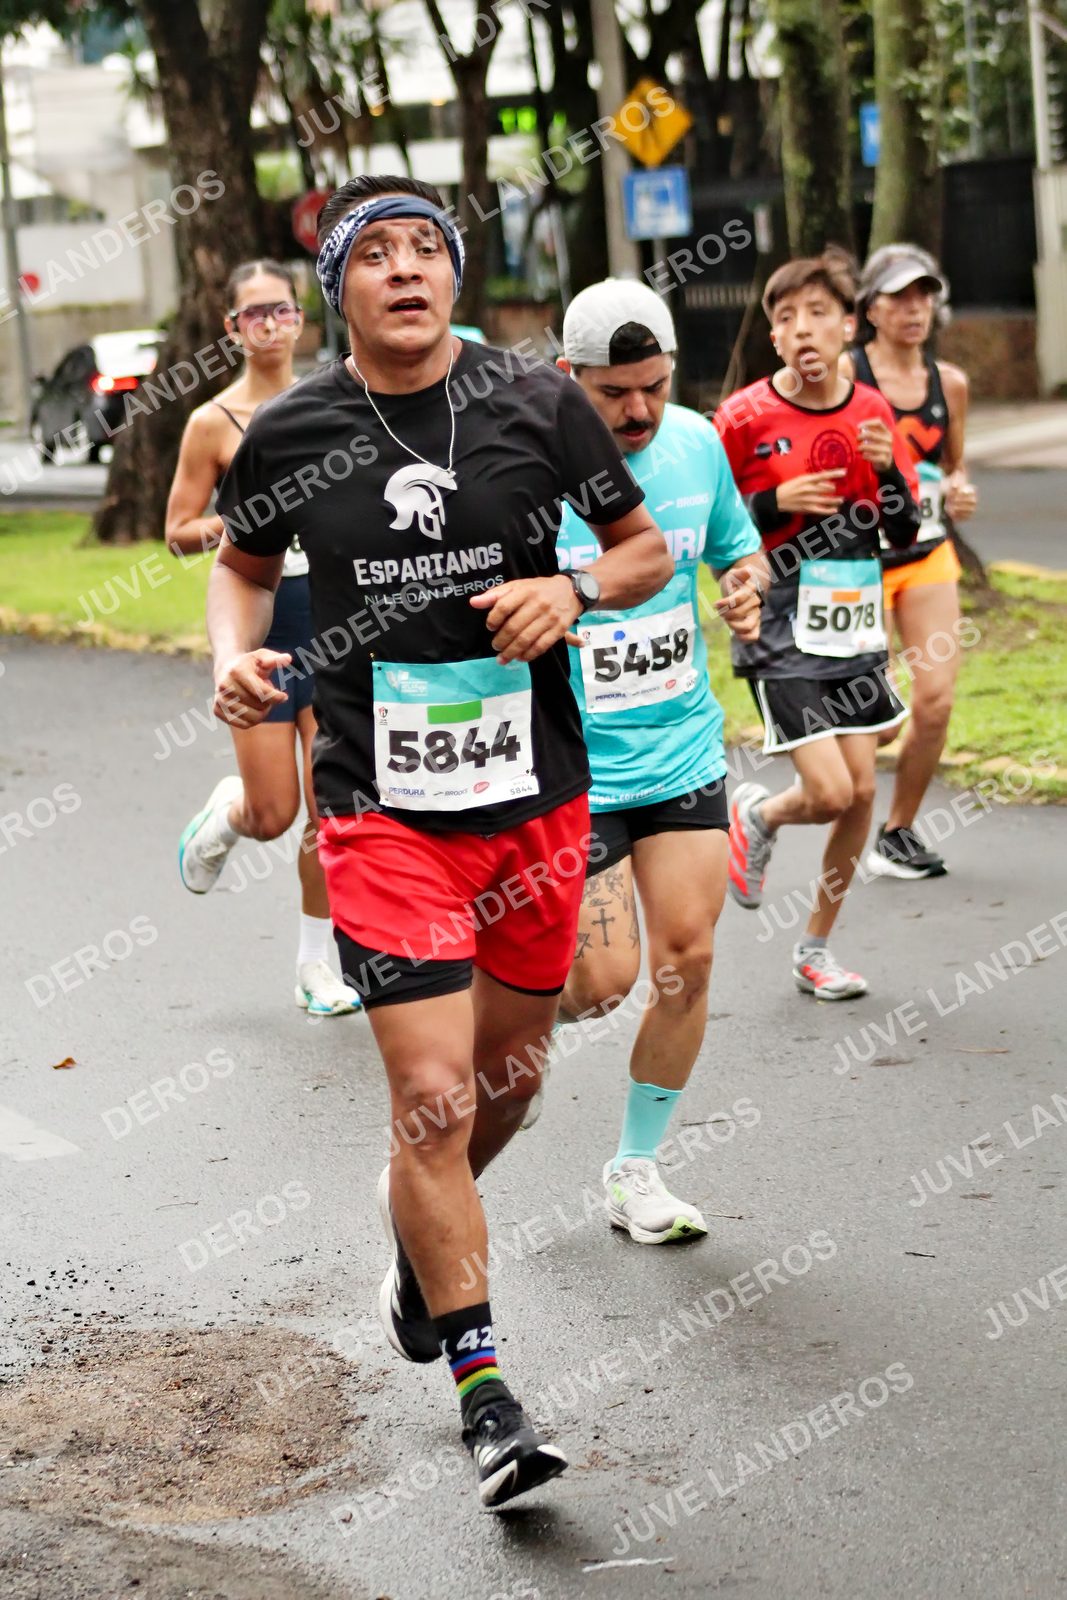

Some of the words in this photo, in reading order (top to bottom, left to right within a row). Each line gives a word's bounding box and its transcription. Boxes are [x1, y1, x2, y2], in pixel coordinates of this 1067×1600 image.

[353, 542, 503, 585] ESPARTANOS
[383, 593, 403, 605] LE
[407, 588, 439, 603] DAN
[444, 574, 504, 598] PERROS
[807, 602, 875, 632] 5078
[593, 628, 689, 682] 5458
[387, 720, 521, 774] 5844
[388, 787, 426, 797] PERDURA
[509, 785, 533, 796] 5844
